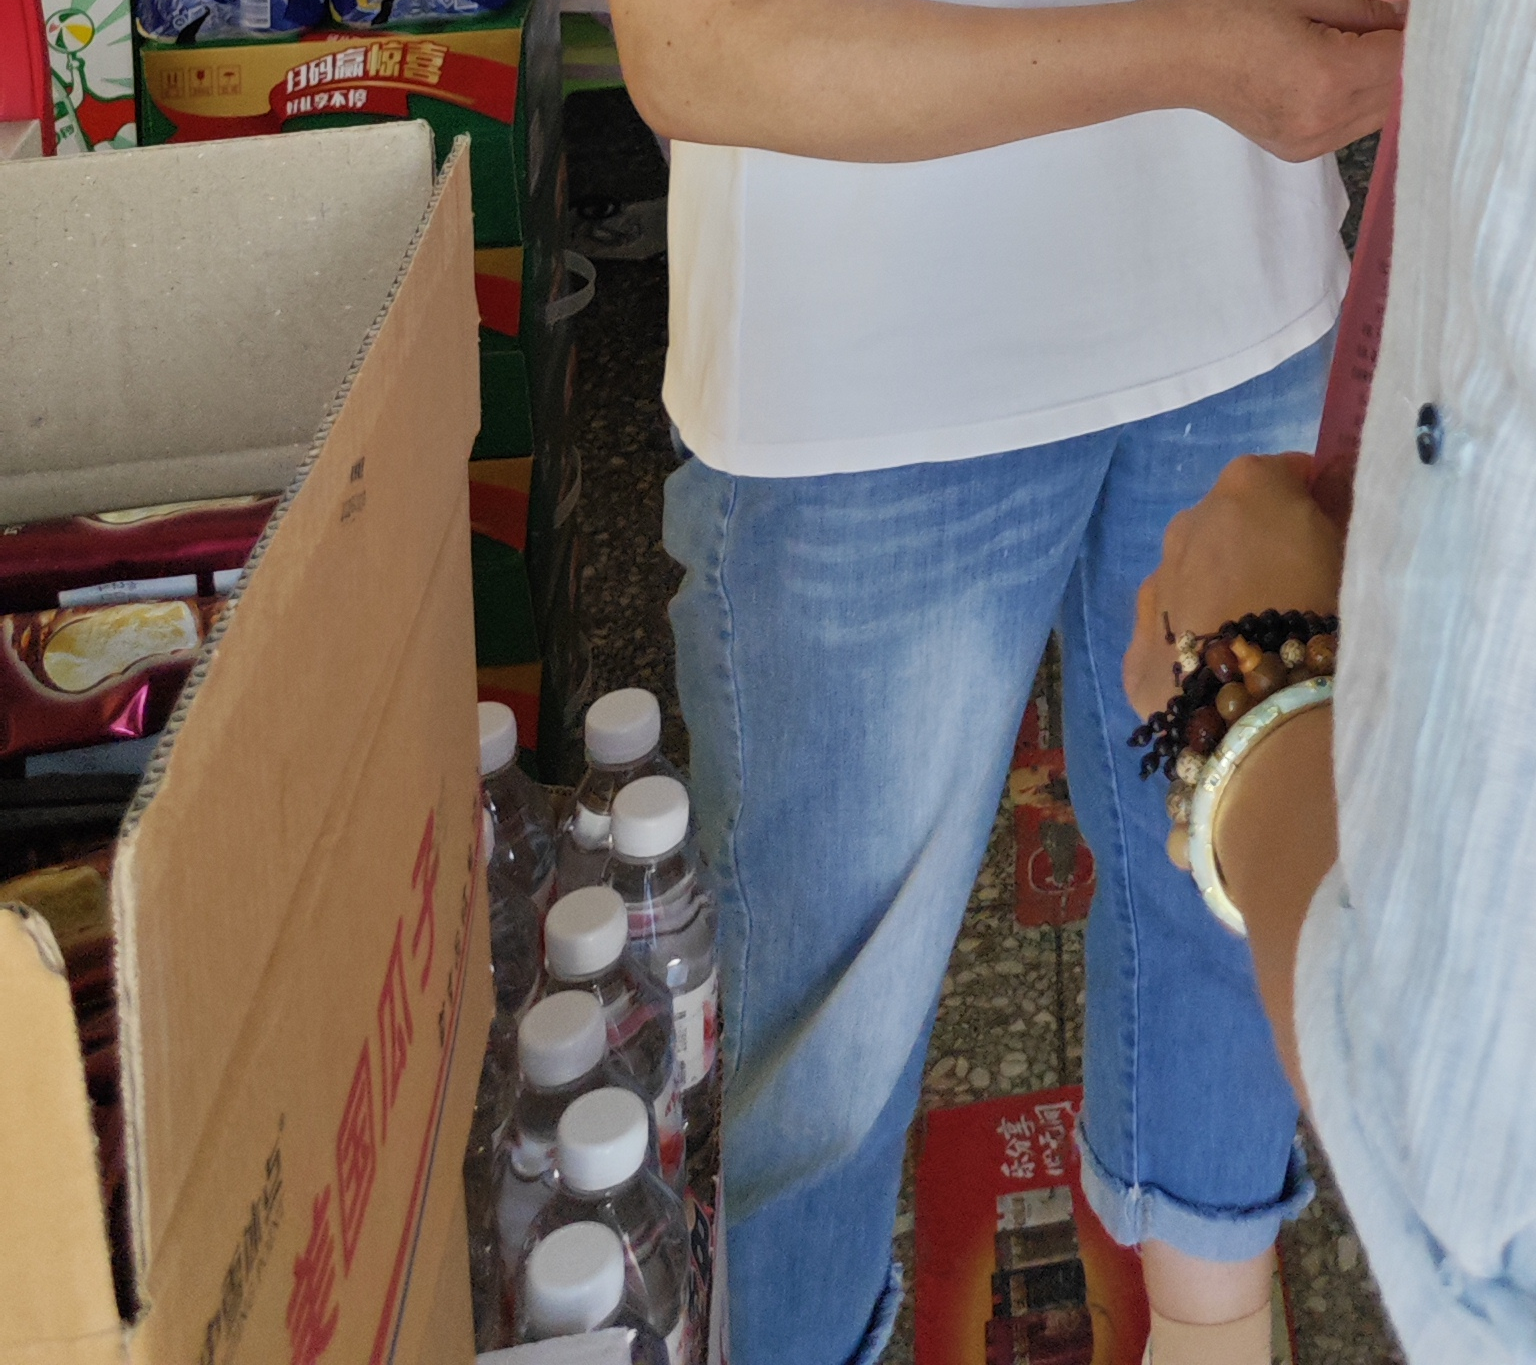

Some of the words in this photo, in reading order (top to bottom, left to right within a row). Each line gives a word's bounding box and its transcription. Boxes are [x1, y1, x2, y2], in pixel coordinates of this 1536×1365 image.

[287, 41, 448, 94] 扫码赢惊喜
[287, 89, 367, 115] 好礼享不停
